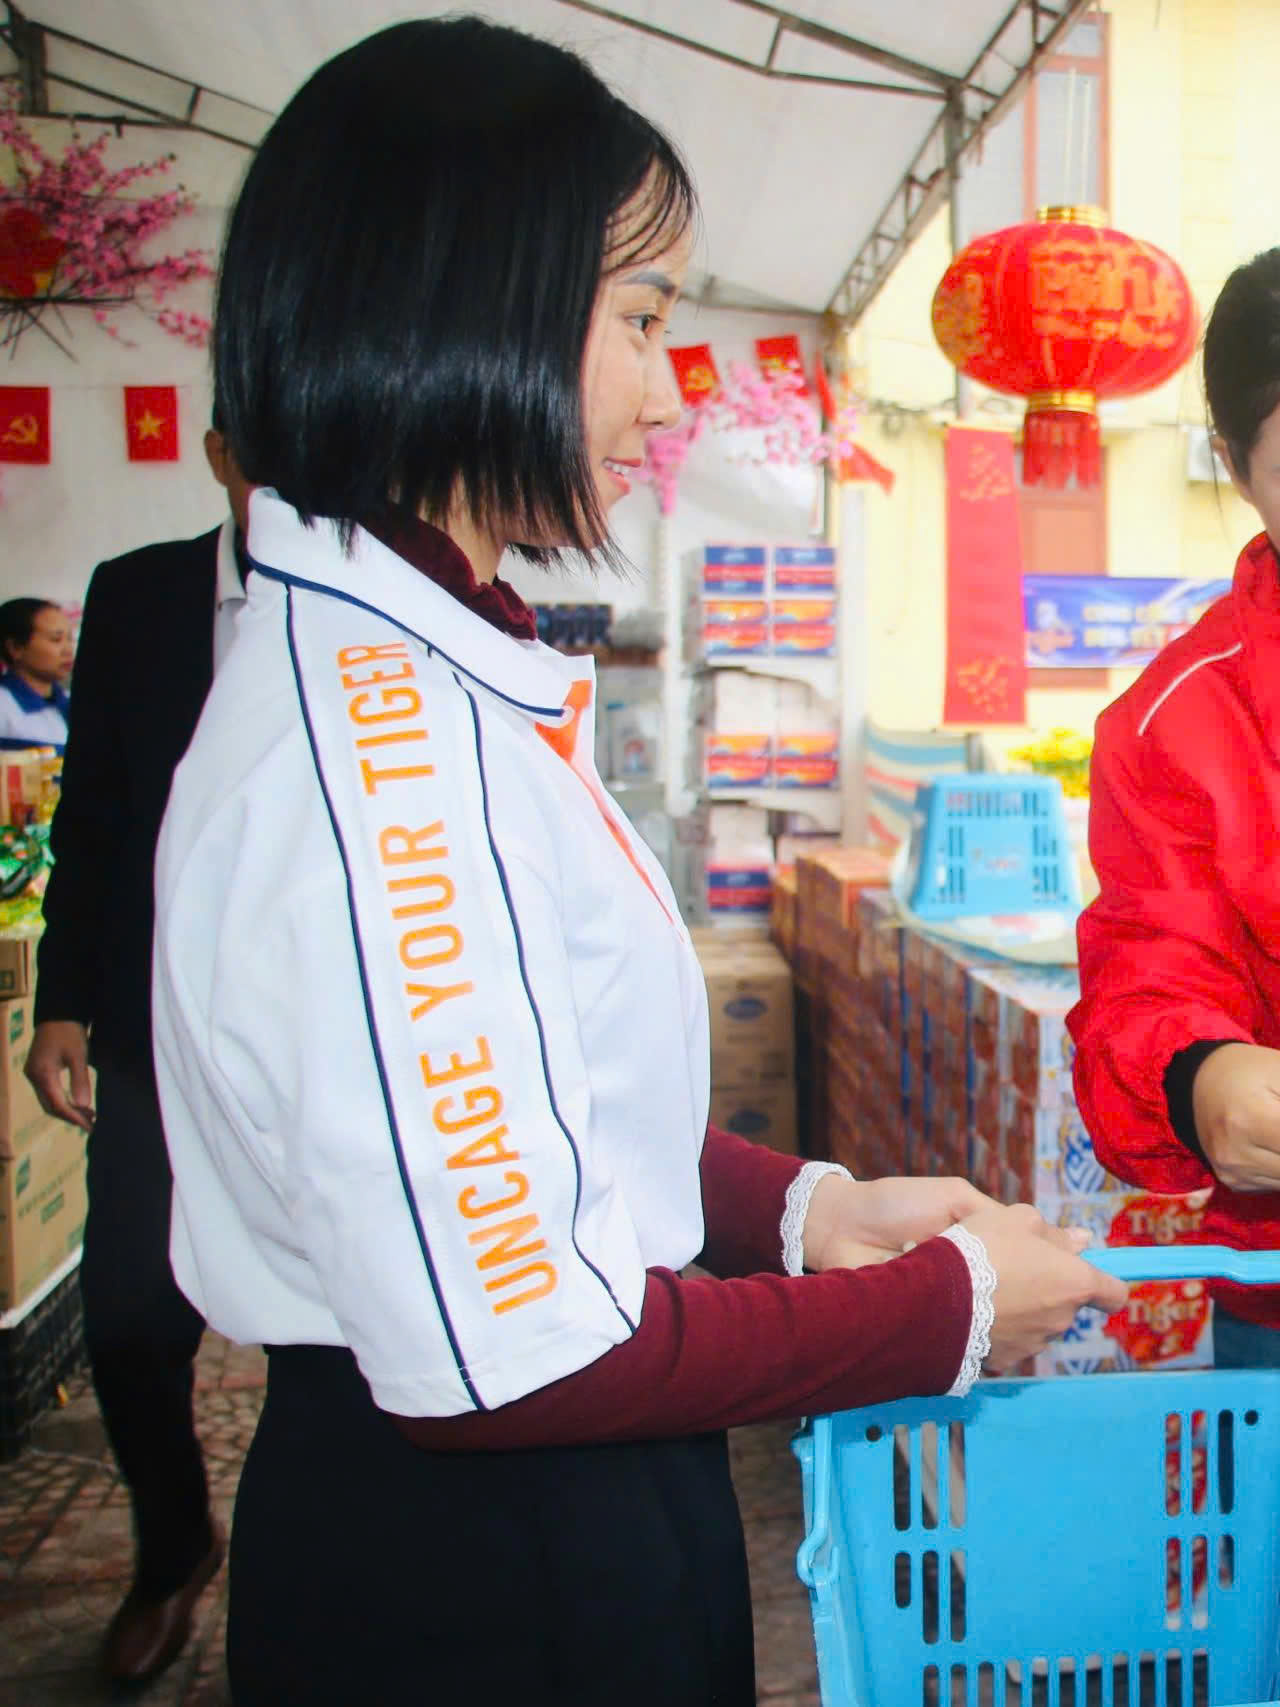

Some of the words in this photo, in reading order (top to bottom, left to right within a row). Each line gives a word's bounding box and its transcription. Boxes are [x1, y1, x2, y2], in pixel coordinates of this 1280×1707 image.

[336, 641, 435, 796] TIGER
[378, 819, 474, 1023] YOUR
[418, 1035, 559, 1316] UNCAGE
[1127, 1202, 1205, 1245] Tiger
[1127, 1292, 1203, 1334] Tiger
